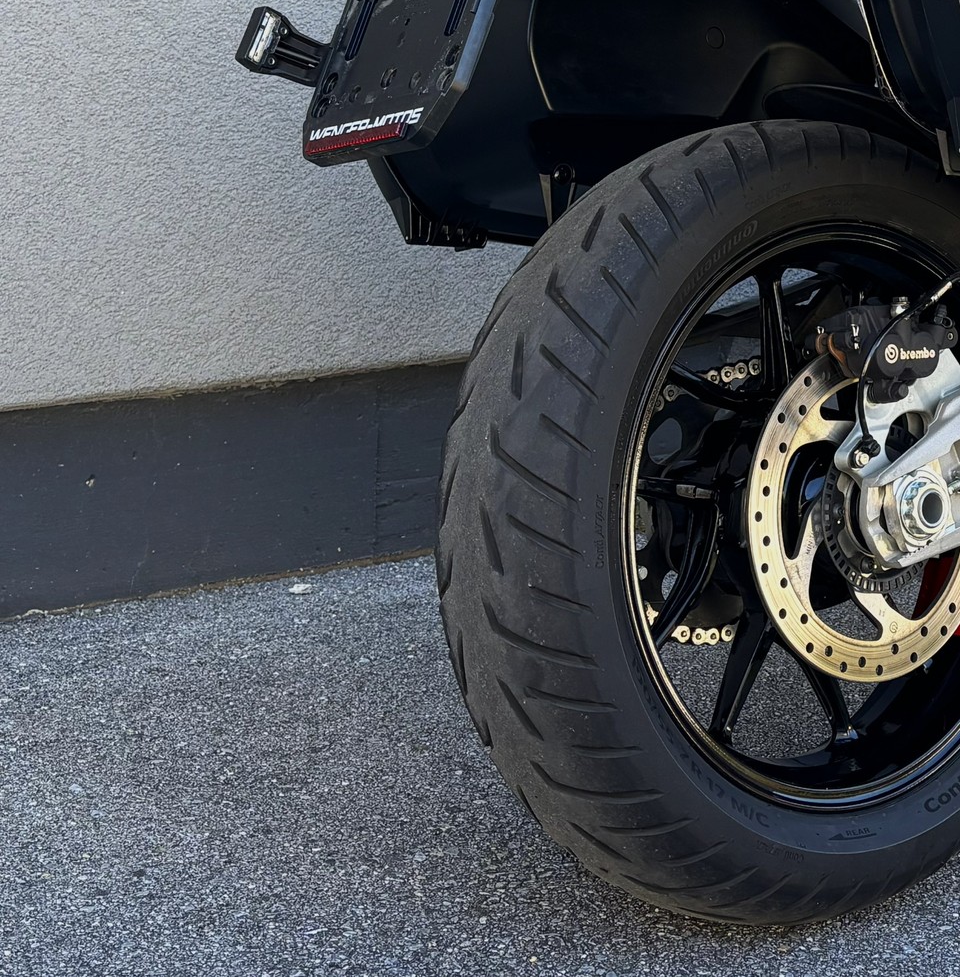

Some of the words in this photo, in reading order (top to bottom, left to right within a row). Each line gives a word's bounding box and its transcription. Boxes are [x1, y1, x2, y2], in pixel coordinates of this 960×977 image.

[900, 347, 936, 360] brembo
[732, 798, 770, 828] M/C
[845, 827, 871, 837] REAR
